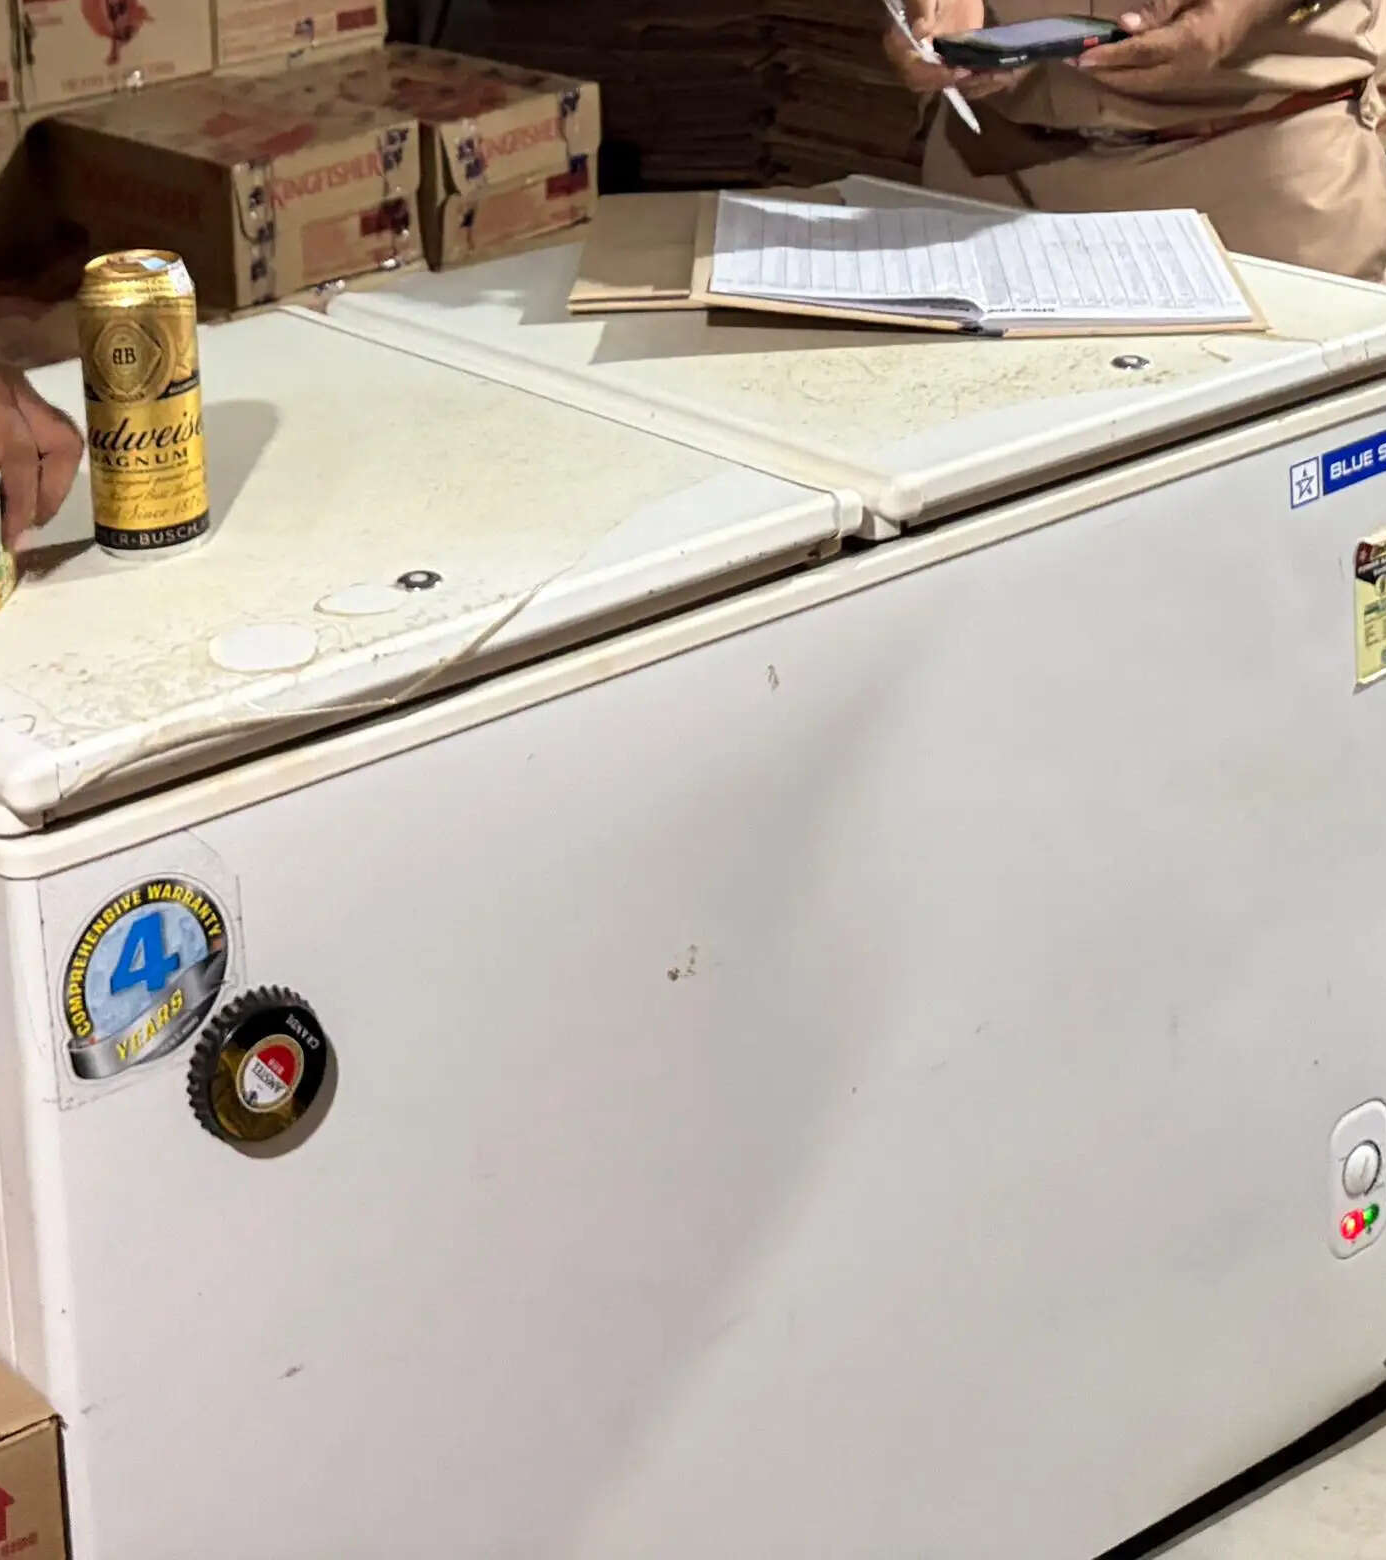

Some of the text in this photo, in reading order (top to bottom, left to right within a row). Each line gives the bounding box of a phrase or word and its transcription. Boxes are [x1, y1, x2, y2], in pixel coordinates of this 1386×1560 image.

[1329, 449, 1374, 481] BLUE
[147, 883, 222, 937] WARRANTY
[110, 910, 180, 996] 4
[116, 988, 184, 1061] YEARS
